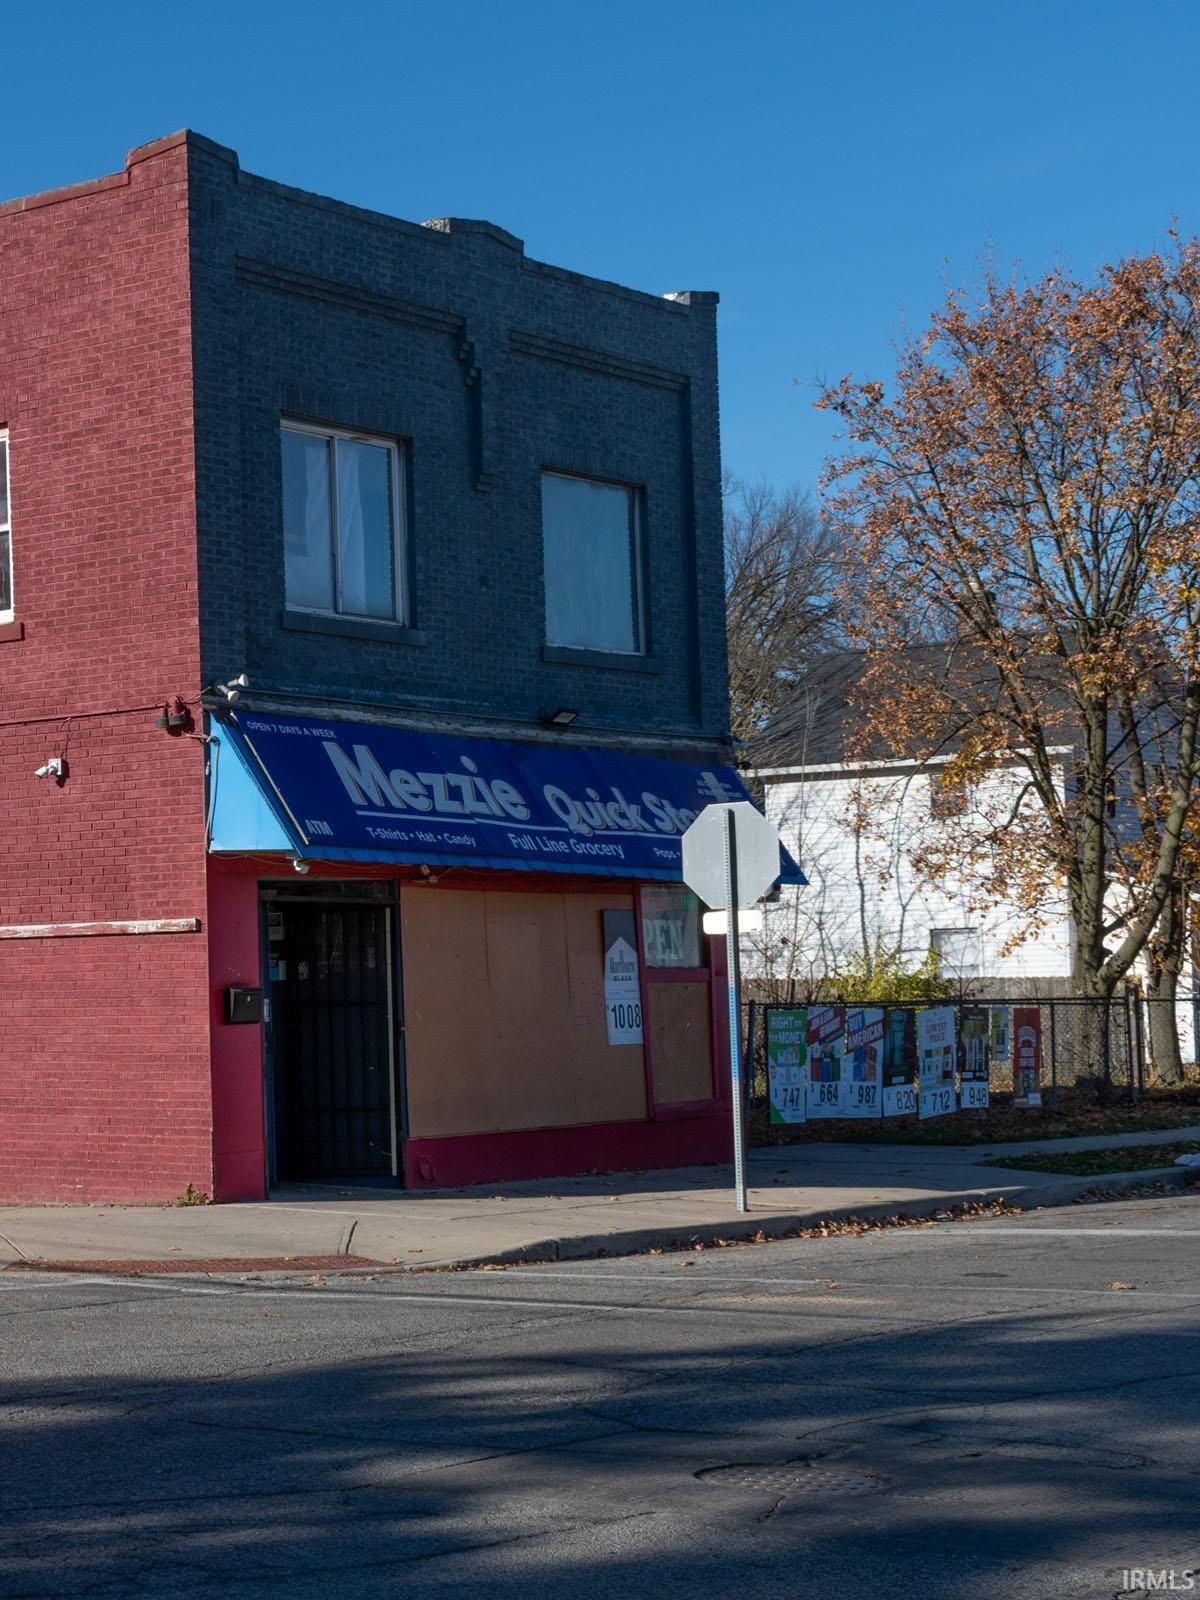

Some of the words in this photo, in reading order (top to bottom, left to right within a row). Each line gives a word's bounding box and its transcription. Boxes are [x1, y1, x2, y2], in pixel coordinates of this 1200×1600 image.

[246, 720, 271, 732] OPEN
[278, 724, 302, 735] DAYS
[304, 728, 310, 736] A
[311, 728, 338, 738] WEEK
[322, 741, 531, 820] Mezzie
[543, 784, 656, 838] Quick
[641, 791, 699, 834] Sto
[304, 819, 334, 836] ATM
[366, 827, 408, 842] T-Shirts
[417, 831, 437, 843] Hat
[444, 833, 477, 848] Candy
[508, 832, 538, 852] Full
[536, 836, 570, 854] Line
[570, 838, 625, 859] Grocery
[643, 919, 684, 960] PEN
[770, 1016, 794, 1029] RIGHT
[848, 1014, 863, 1032] BUY
[779, 1032, 806, 1044] MONEY
[848, 1022, 884, 1048] AMERICAN
